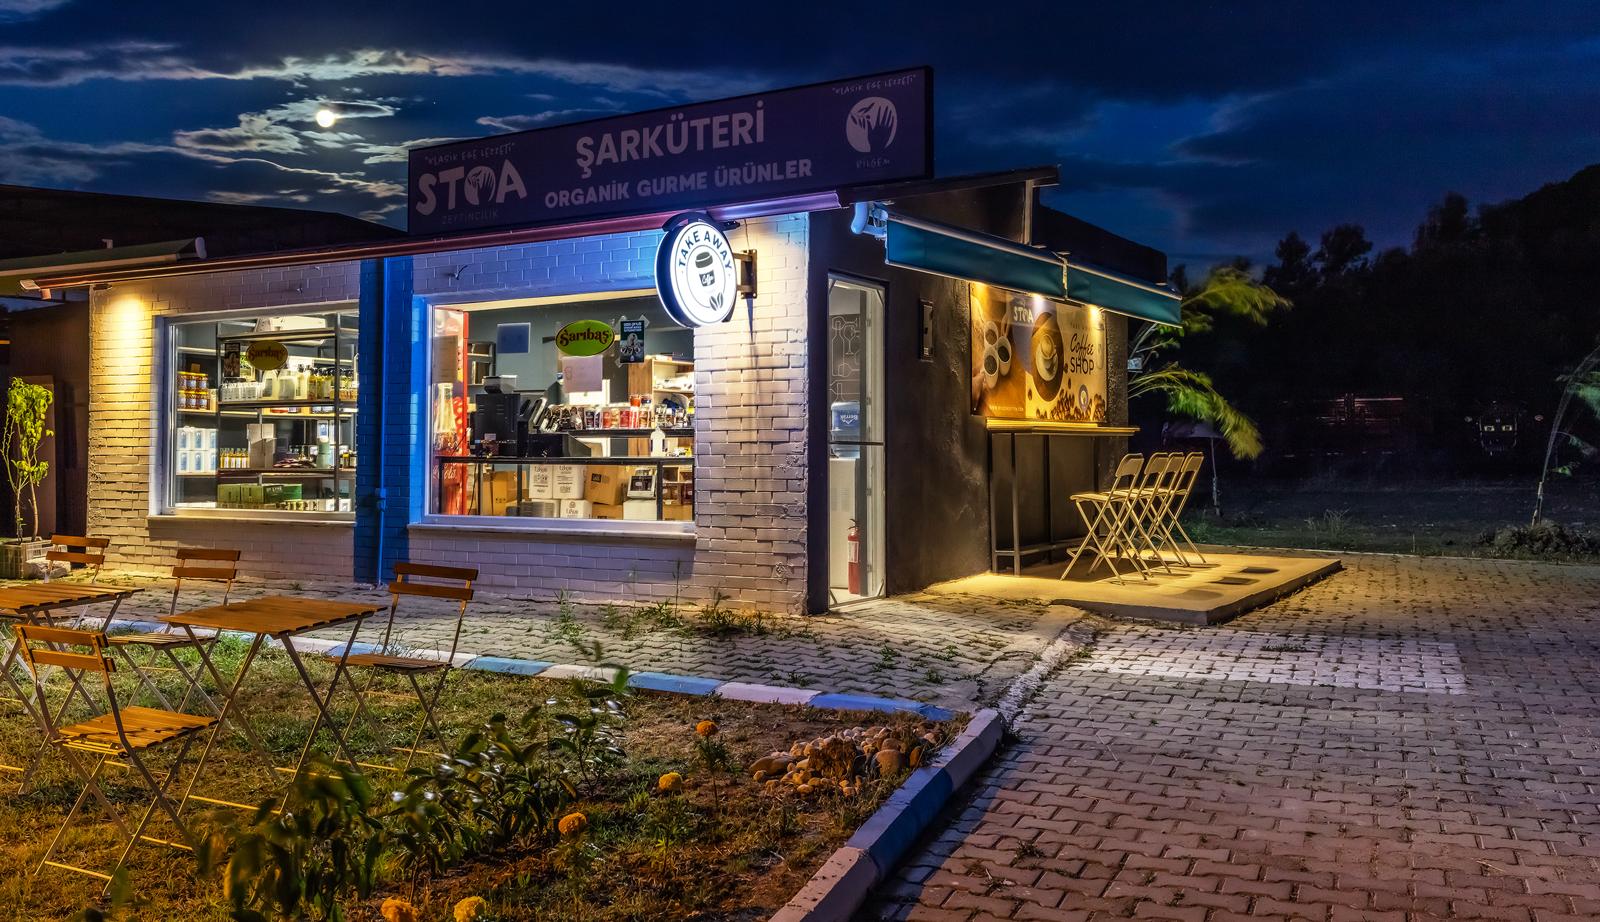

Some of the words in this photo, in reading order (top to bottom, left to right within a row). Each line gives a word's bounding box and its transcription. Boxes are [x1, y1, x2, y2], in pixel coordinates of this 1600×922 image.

[576, 100, 765, 179] ŞARKÜTERİ
[415, 159, 528, 215] STOA
[545, 181, 630, 208] ORGANİK
[636, 171, 708, 197] GURME
[714, 158, 813, 188] ÜRÜNLER
[678, 230, 701, 268] TAKE
[703, 230, 733, 271] AWAY
[1012, 305, 1034, 323] STOA
[1070, 333, 1094, 358] Coffee
[1070, 356, 1095, 375] SHOP
